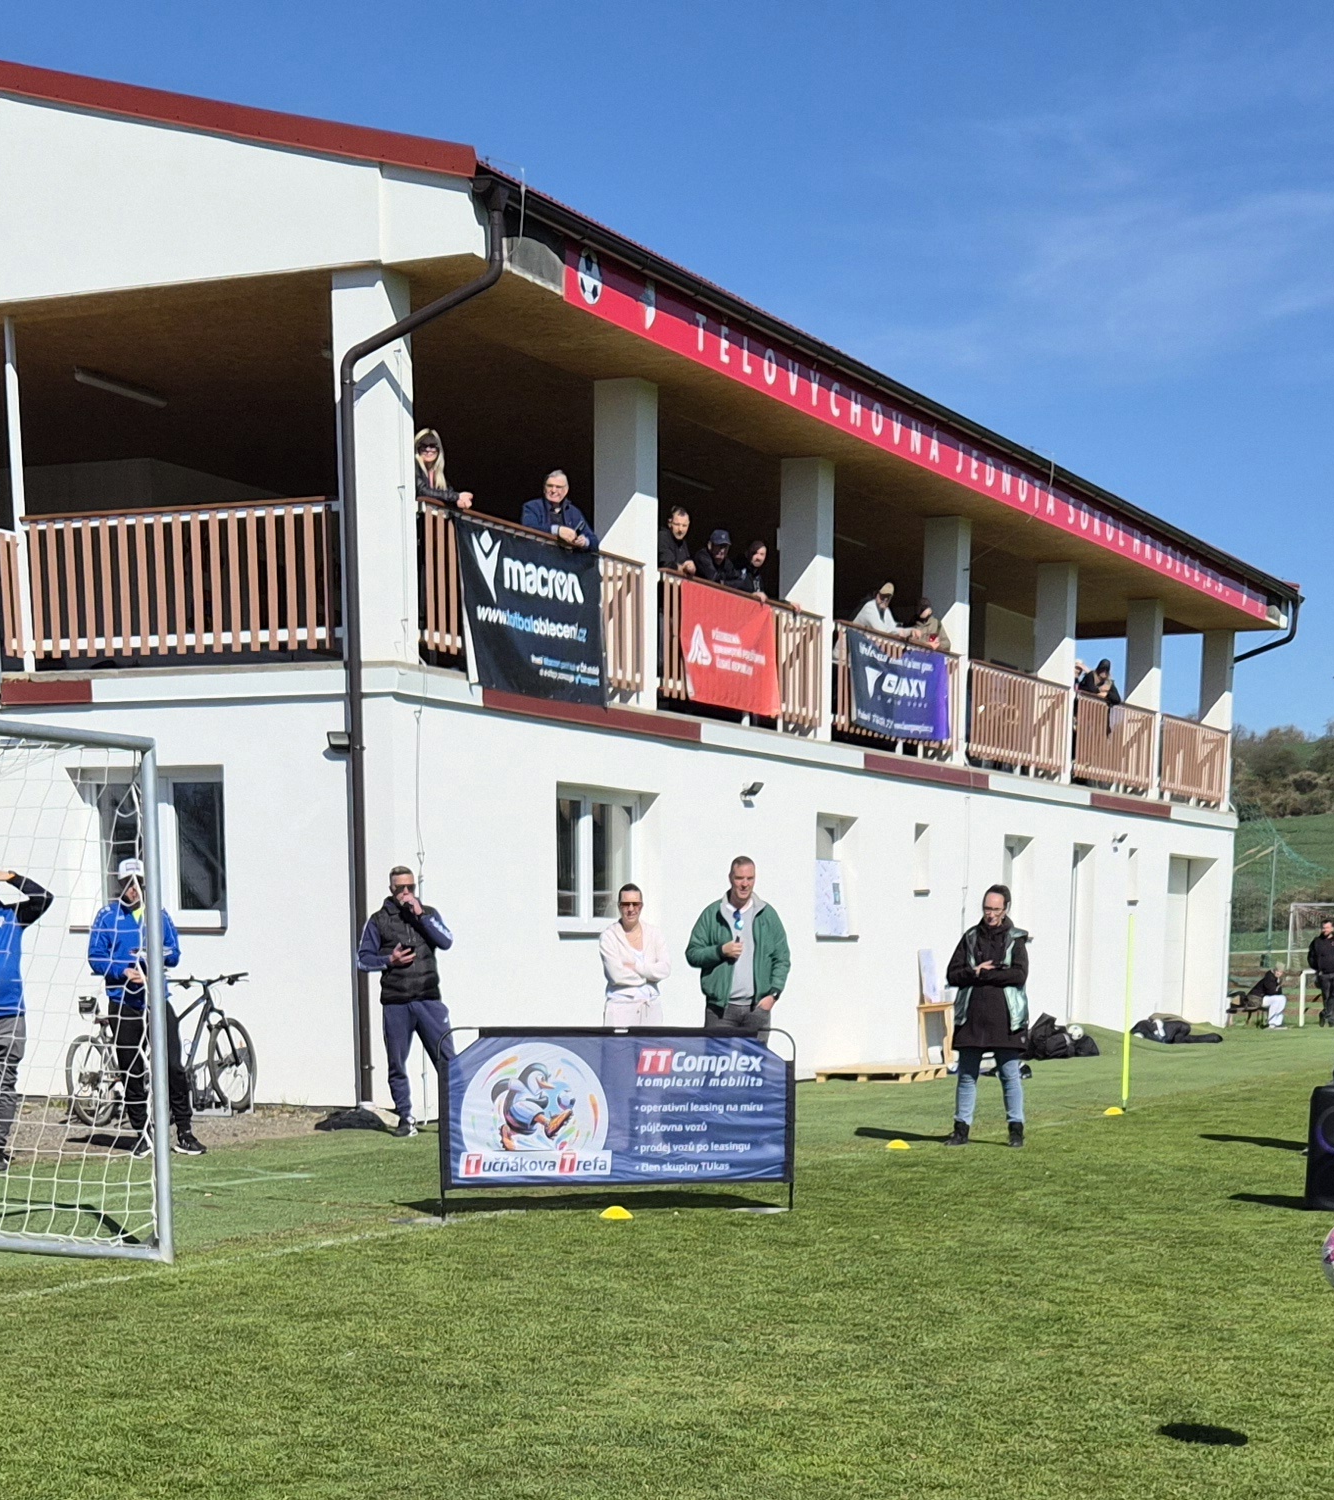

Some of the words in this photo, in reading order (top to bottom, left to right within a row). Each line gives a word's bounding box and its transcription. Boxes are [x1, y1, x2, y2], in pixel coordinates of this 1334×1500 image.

[695, 310, 940, 463] TĚLOVÝCHOVNÁ
[955, 443, 1055, 517] JEDNOTA
[1067, 497, 1125, 547] SOKOL
[503, 557, 585, 605] macron
[642, 1050, 764, 1076] TTComplex
[636, 1076, 706, 1089] komplexní
[709, 1076, 763, 1087] mobilita
[640, 1101, 689, 1114] operativní
[690, 1101, 724, 1114] leasing
[726, 1103, 738, 1112] na
[740, 1101, 763, 1112] míru
[640, 1121, 683, 1134] půjčovna
[685, 1121, 707, 1132] vozů
[640, 1142, 671, 1154] prodej
[672, 1141, 695, 1151] vozů
[696, 1144, 709, 1153] po
[710, 1141, 751, 1153] leasingu
[466, 1154, 557, 1174] Tučňákova
[561, 1153, 608, 1173] Trefa
[640, 1161, 660, 1171] člen
[662, 1162, 699, 1173] skupiny
[700, 1162, 730, 1171] TUkas
